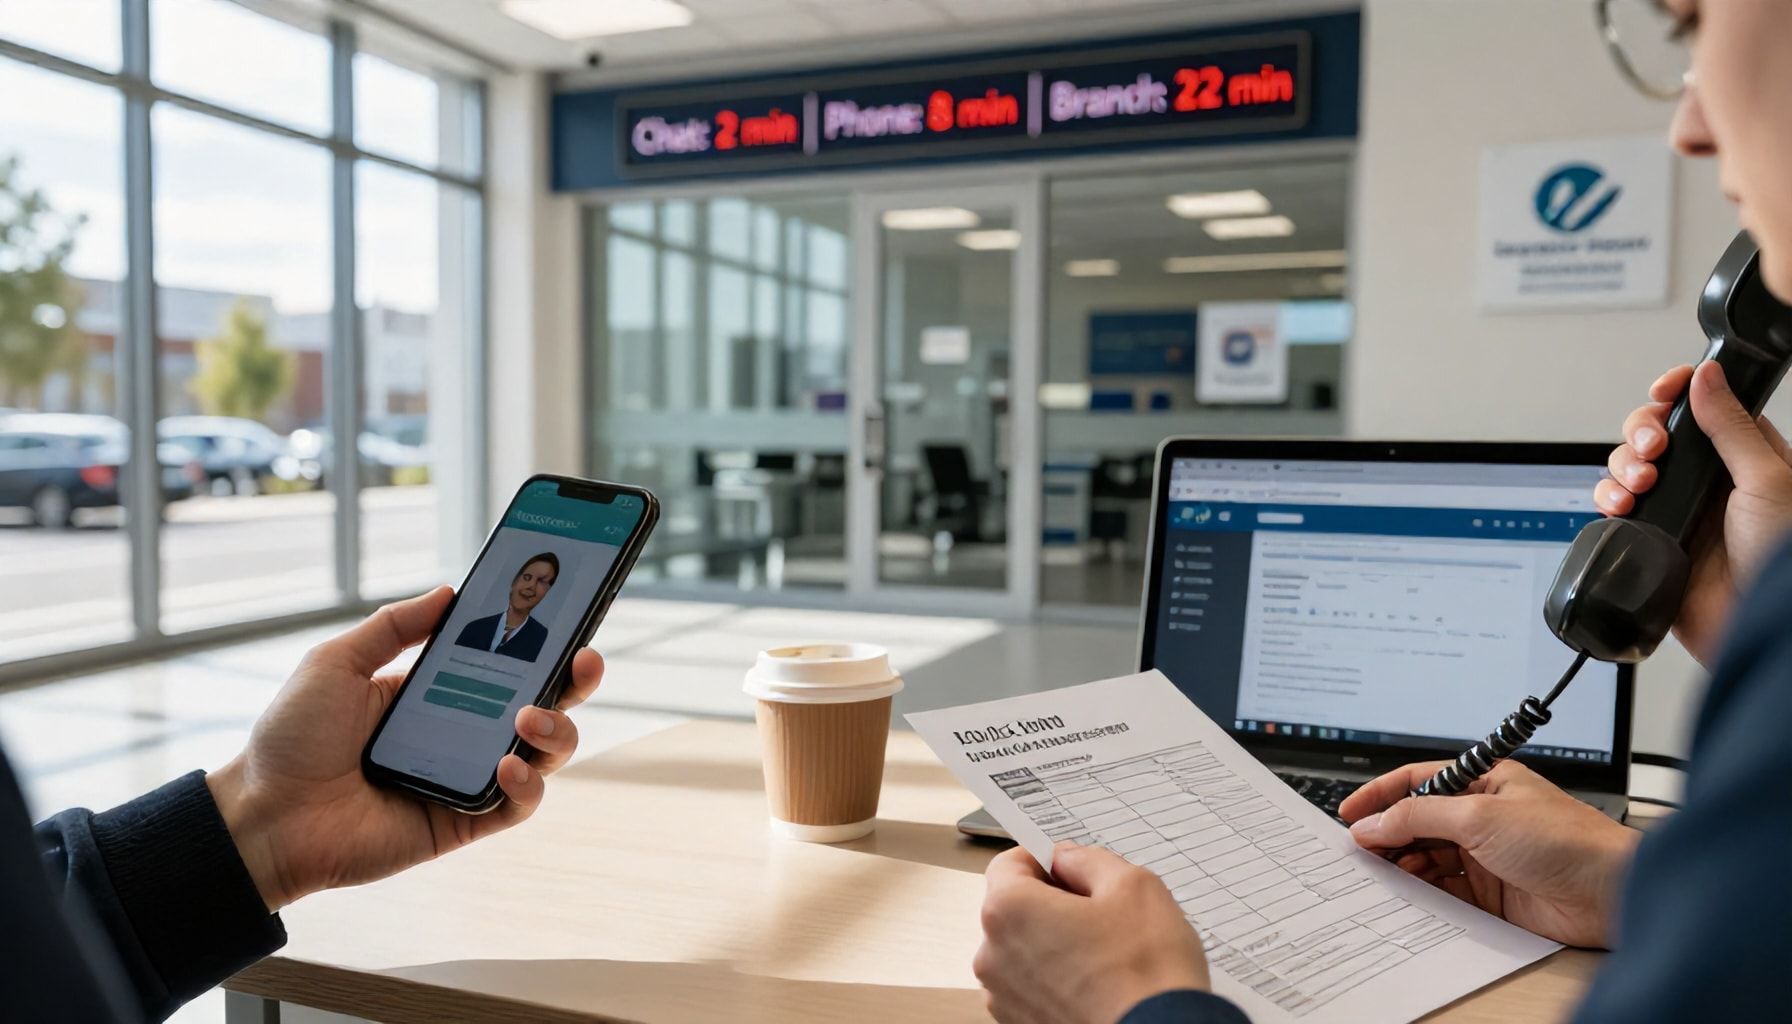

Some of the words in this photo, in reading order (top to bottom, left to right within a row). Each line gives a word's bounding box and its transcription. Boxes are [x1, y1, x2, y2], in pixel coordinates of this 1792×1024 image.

[714, 110, 739, 150] 2
[741, 108, 797, 145] min
[927, 90, 954, 132] 8
[957, 87, 1018, 128] min
[1174, 66, 1224, 112] 22
[1228, 64, 1293, 106] min
